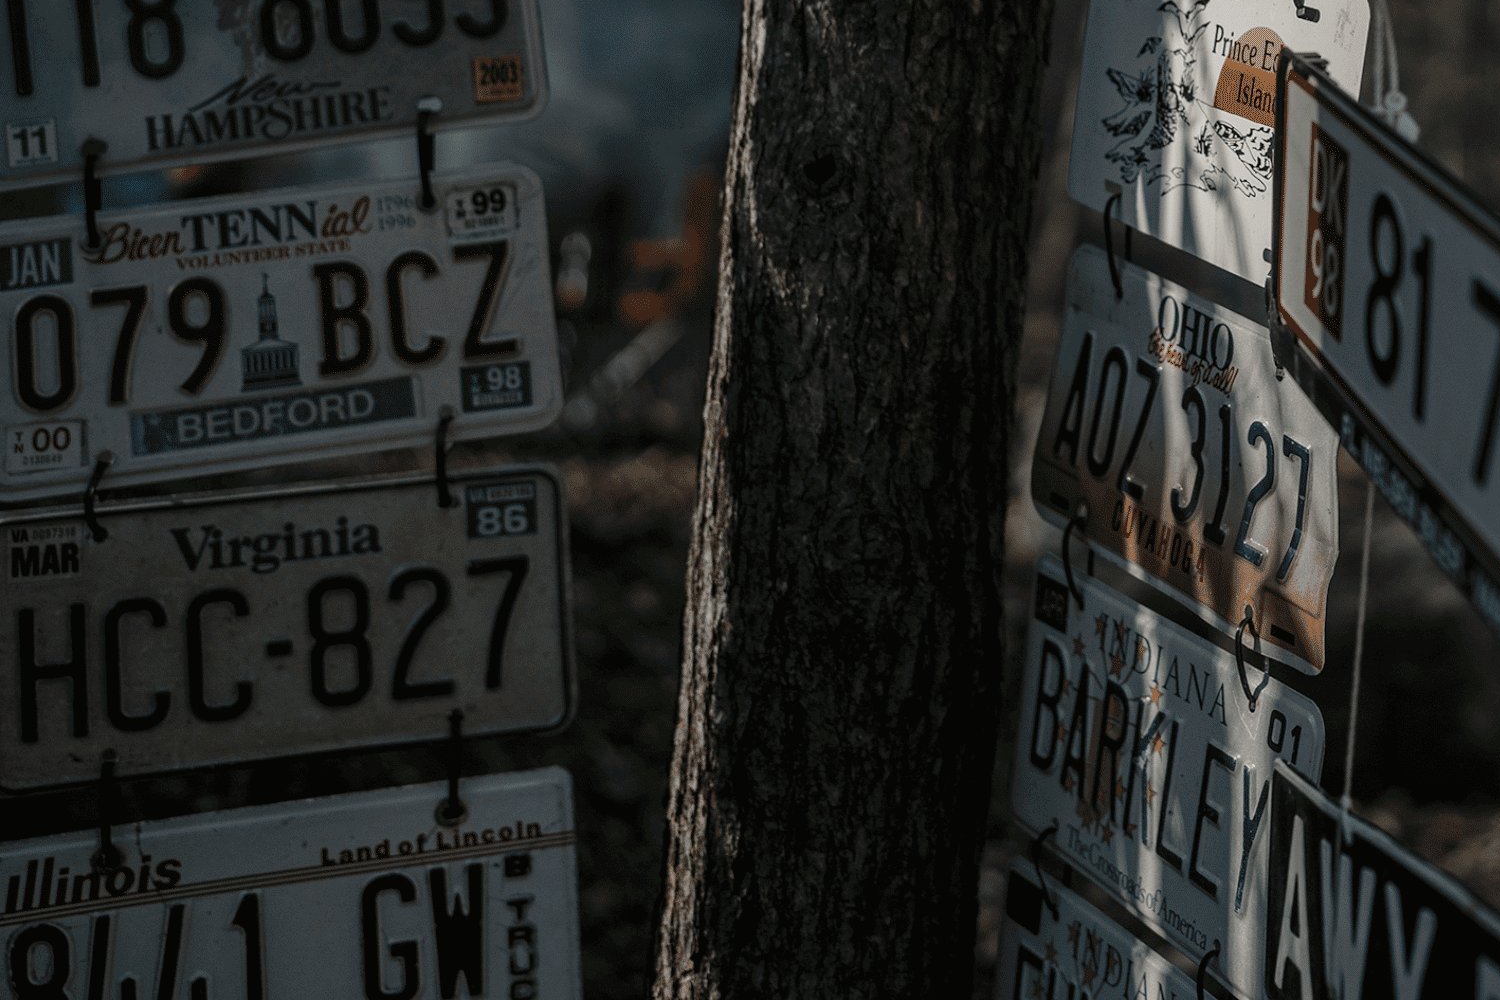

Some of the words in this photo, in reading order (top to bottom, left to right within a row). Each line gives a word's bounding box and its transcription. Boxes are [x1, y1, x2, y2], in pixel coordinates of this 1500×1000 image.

[1211, 24, 1258, 67] Prince
[144, 85, 395, 154] HAMPSHIRE
[189, 73, 343, 112] New
[1235, 72, 1277, 117] Islan
[12, 126, 48, 157] 11
[471, 188, 507, 216] 99
[1311, 137, 1346, 237] DK
[8, 243, 62, 287] JAN
[175, 246, 292, 271] VOLUNTEER
[295, 239, 352, 259] STATE
[1310, 228, 1340, 318] 98
[14, 276, 227, 413] 079
[311, 240, 519, 378] BCZ
[1158, 295, 1235, 372] OHIO
[1365, 193, 1433, 422] 81
[486, 365, 522, 392] 98
[32, 425, 72, 453] 00
[176, 390, 376, 444] BEDFORD
[1170, 385, 1313, 583] 3127
[12, 529, 29, 543] VA
[171, 516, 383, 575] Virginia
[477, 504, 528, 536] 86
[1111, 499, 1207, 584] CUYAHOGA
[12, 542, 79, 578] MAR
[16, 554, 531, 743] HCC-827
[1098, 612, 1229, 728] INDIANA
[1266, 708, 1303, 767] 01
[1029, 638, 1271, 914] BARKLEY
[321, 839, 390, 868] Land
[396, 833, 427, 858] of
[436, 820, 543, 852] Lincoln
[4, 853, 183, 915] Illinois
[1089, 842, 1147, 904] Crossroads
[1145, 889, 1162, 917] of
[1159, 896, 1208, 950] America
[361, 862, 484, 1000] GW
